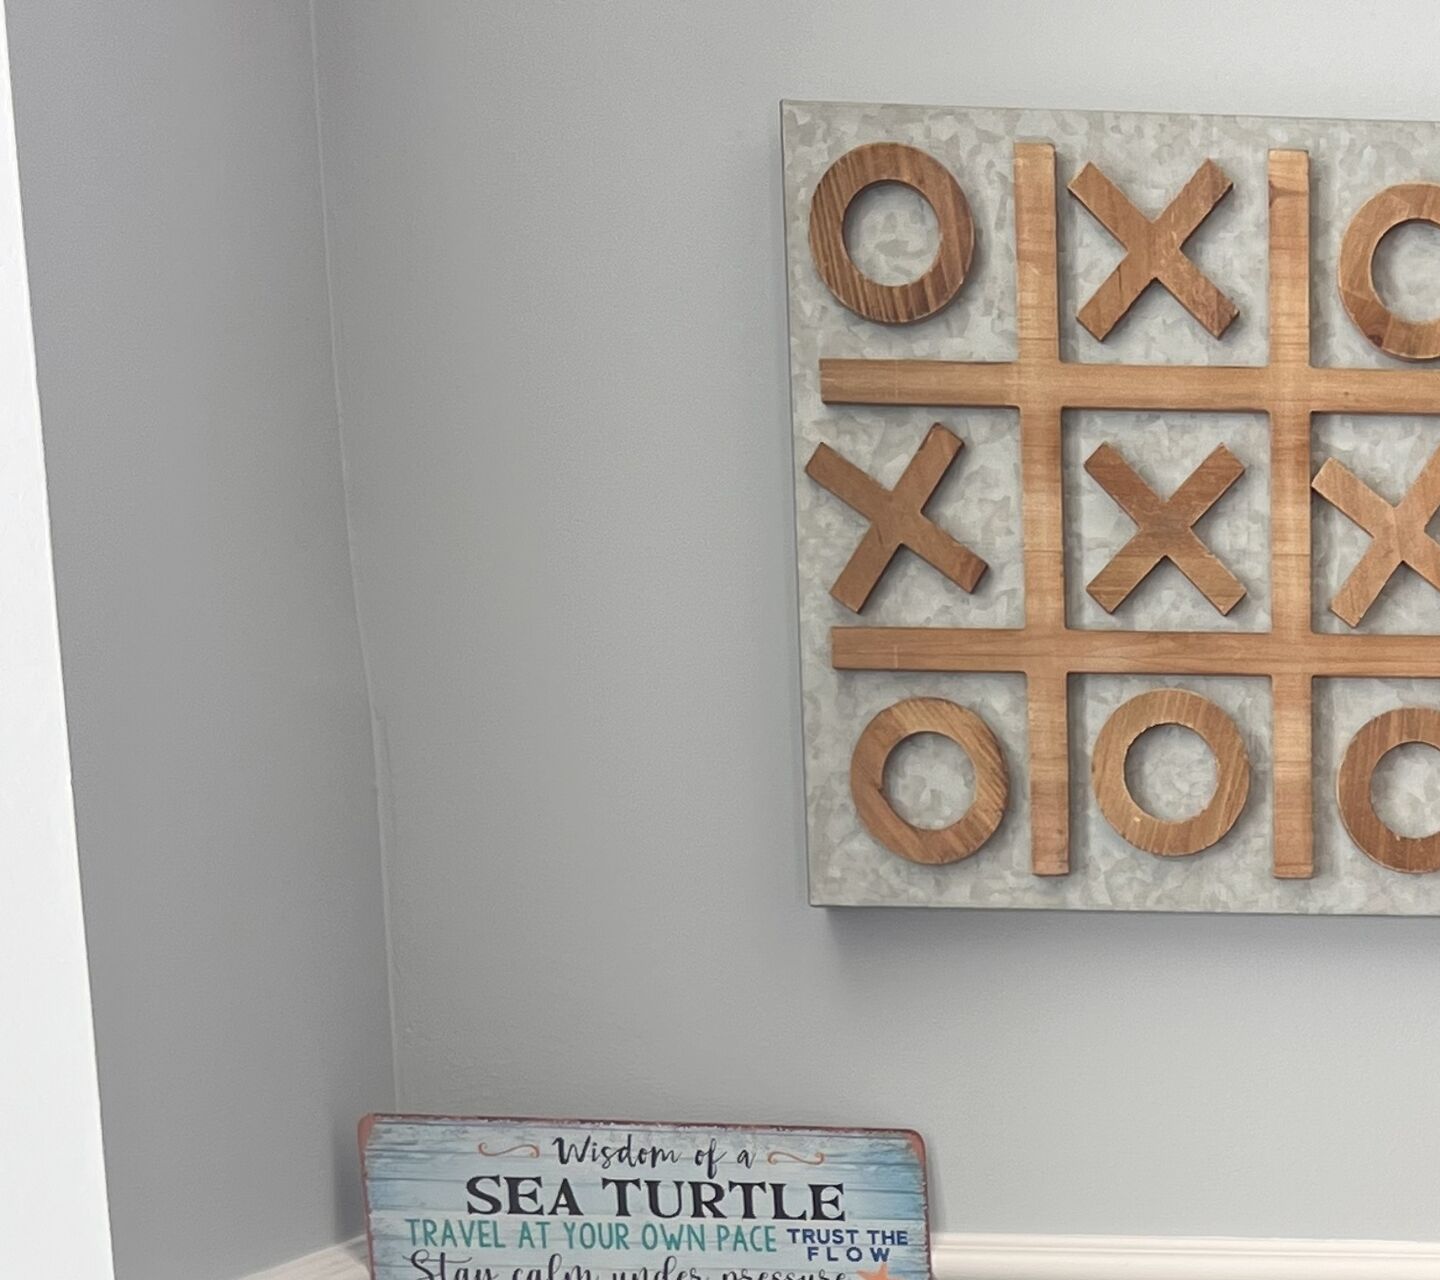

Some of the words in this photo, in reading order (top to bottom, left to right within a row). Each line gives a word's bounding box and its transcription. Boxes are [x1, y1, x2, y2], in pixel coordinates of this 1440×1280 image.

[553, 1134, 681, 1168] Wisdom
[695, 1138, 727, 1179] of
[737, 1147, 757, 1169] a
[466, 1175, 584, 1216] SEA
[602, 1178, 845, 1222] TURTLE
[405, 1219, 506, 1248] TRAVEL
[518, 1221, 550, 1248] AT
[564, 1223, 630, 1250] YOUR
[642, 1223, 706, 1251] OWN
[718, 1225, 777, 1252] PACE
[787, 1228, 859, 1244] TRUST
[867, 1230, 908, 1246] THE
